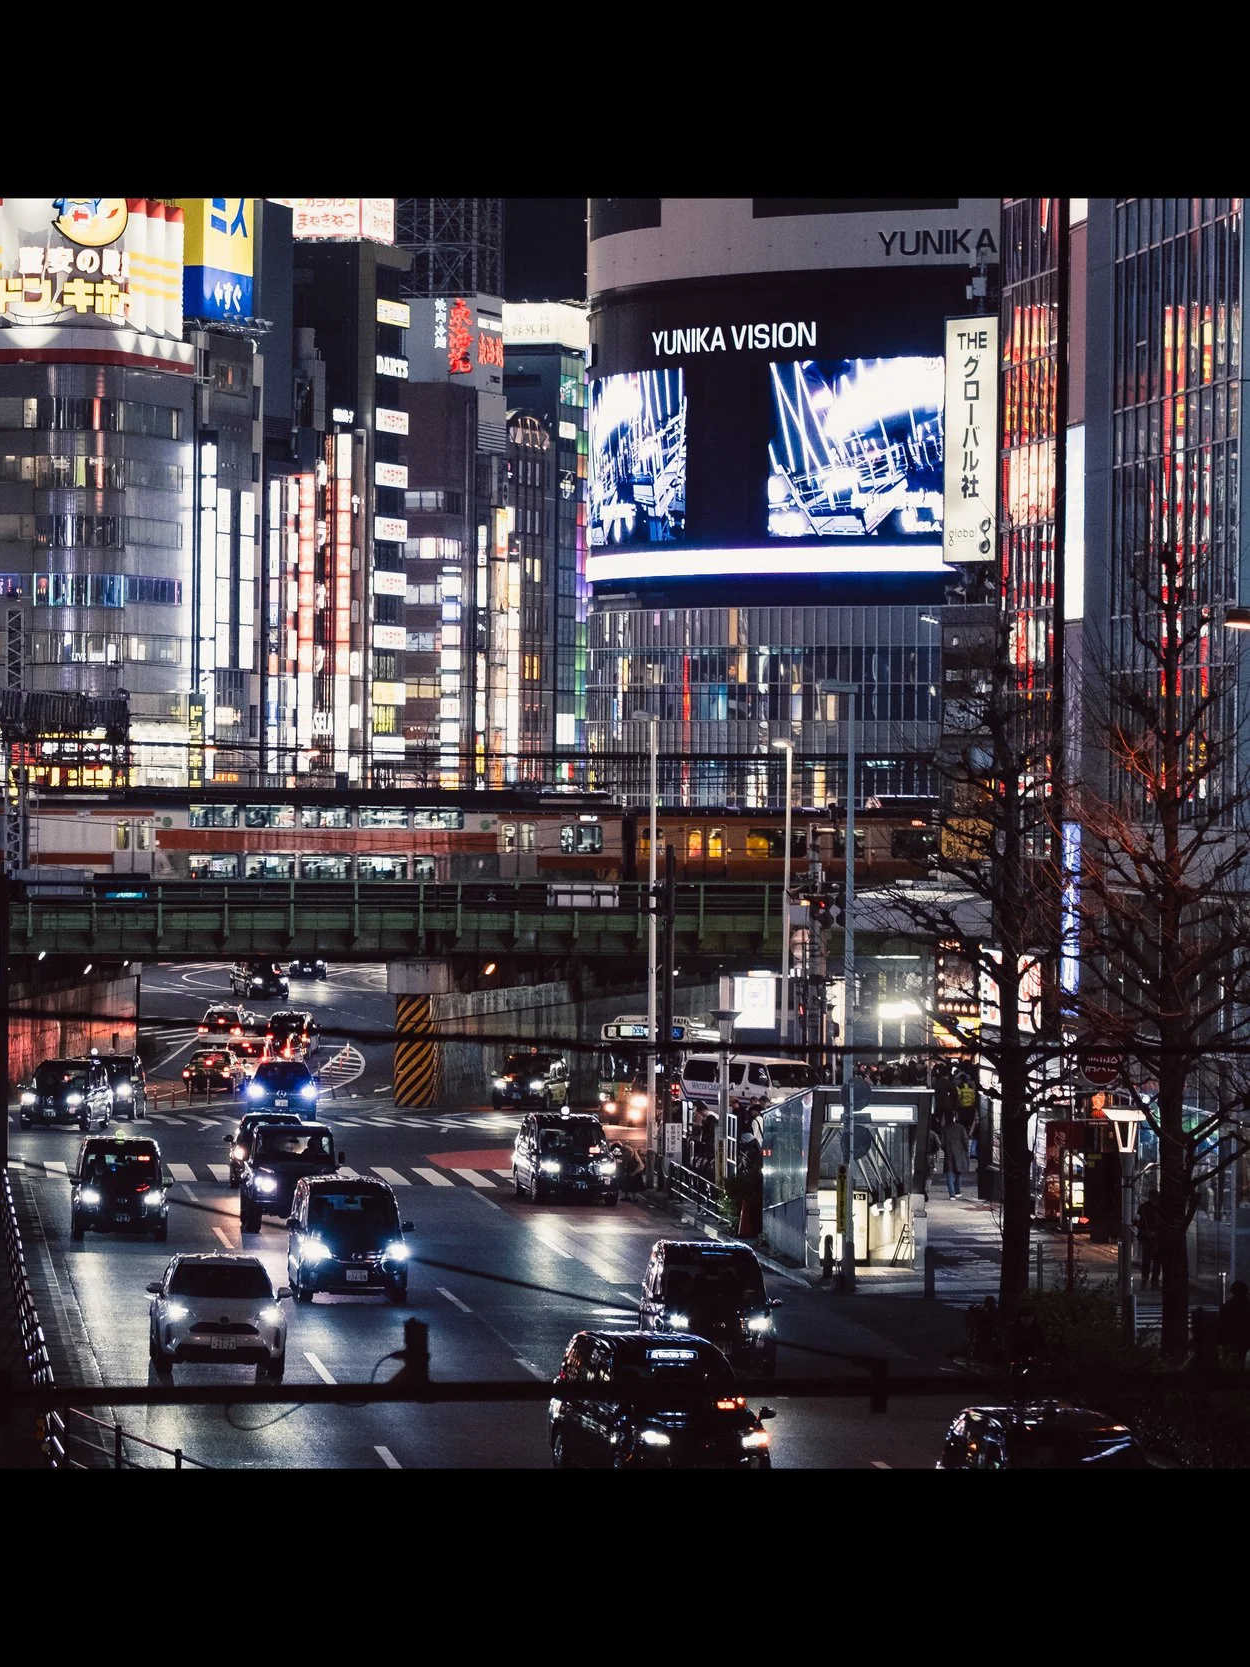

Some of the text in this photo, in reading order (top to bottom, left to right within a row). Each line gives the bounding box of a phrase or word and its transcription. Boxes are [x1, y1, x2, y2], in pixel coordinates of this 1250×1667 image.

[296, 213, 355, 230] まねきねこ
[878, 228, 997, 256] YUNIKA
[652, 321, 817, 356] YUNIKA VISION
[957, 331, 988, 350] THE
[376, 355, 408, 379] DARTS
[961, 354, 981, 499] グローバル社
[692, 1082, 707, 1090] WATER
